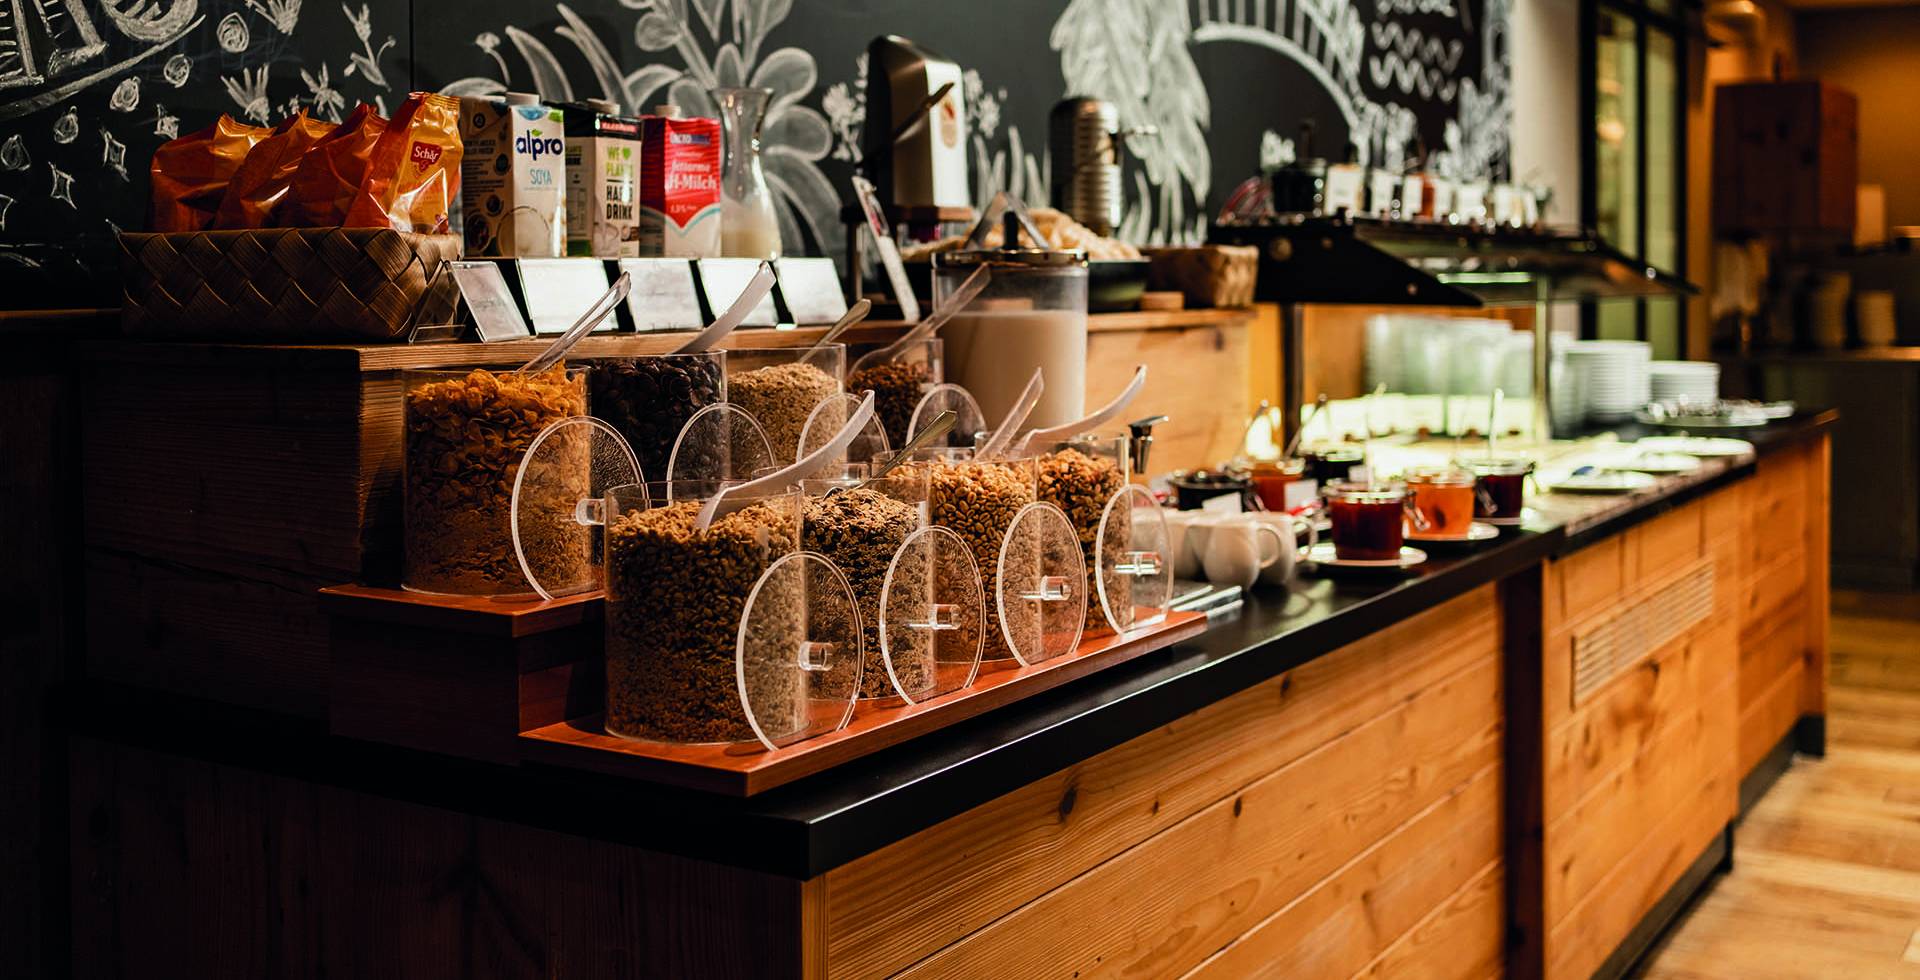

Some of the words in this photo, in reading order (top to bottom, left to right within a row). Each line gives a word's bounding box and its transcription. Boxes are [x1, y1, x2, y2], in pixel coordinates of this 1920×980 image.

[516, 129, 563, 161] alpro
[607, 146, 620, 160] WE
[529, 169, 552, 185] SOYA
[667, 173, 717, 191] H-Milch
[606, 203, 633, 220] DRINK
